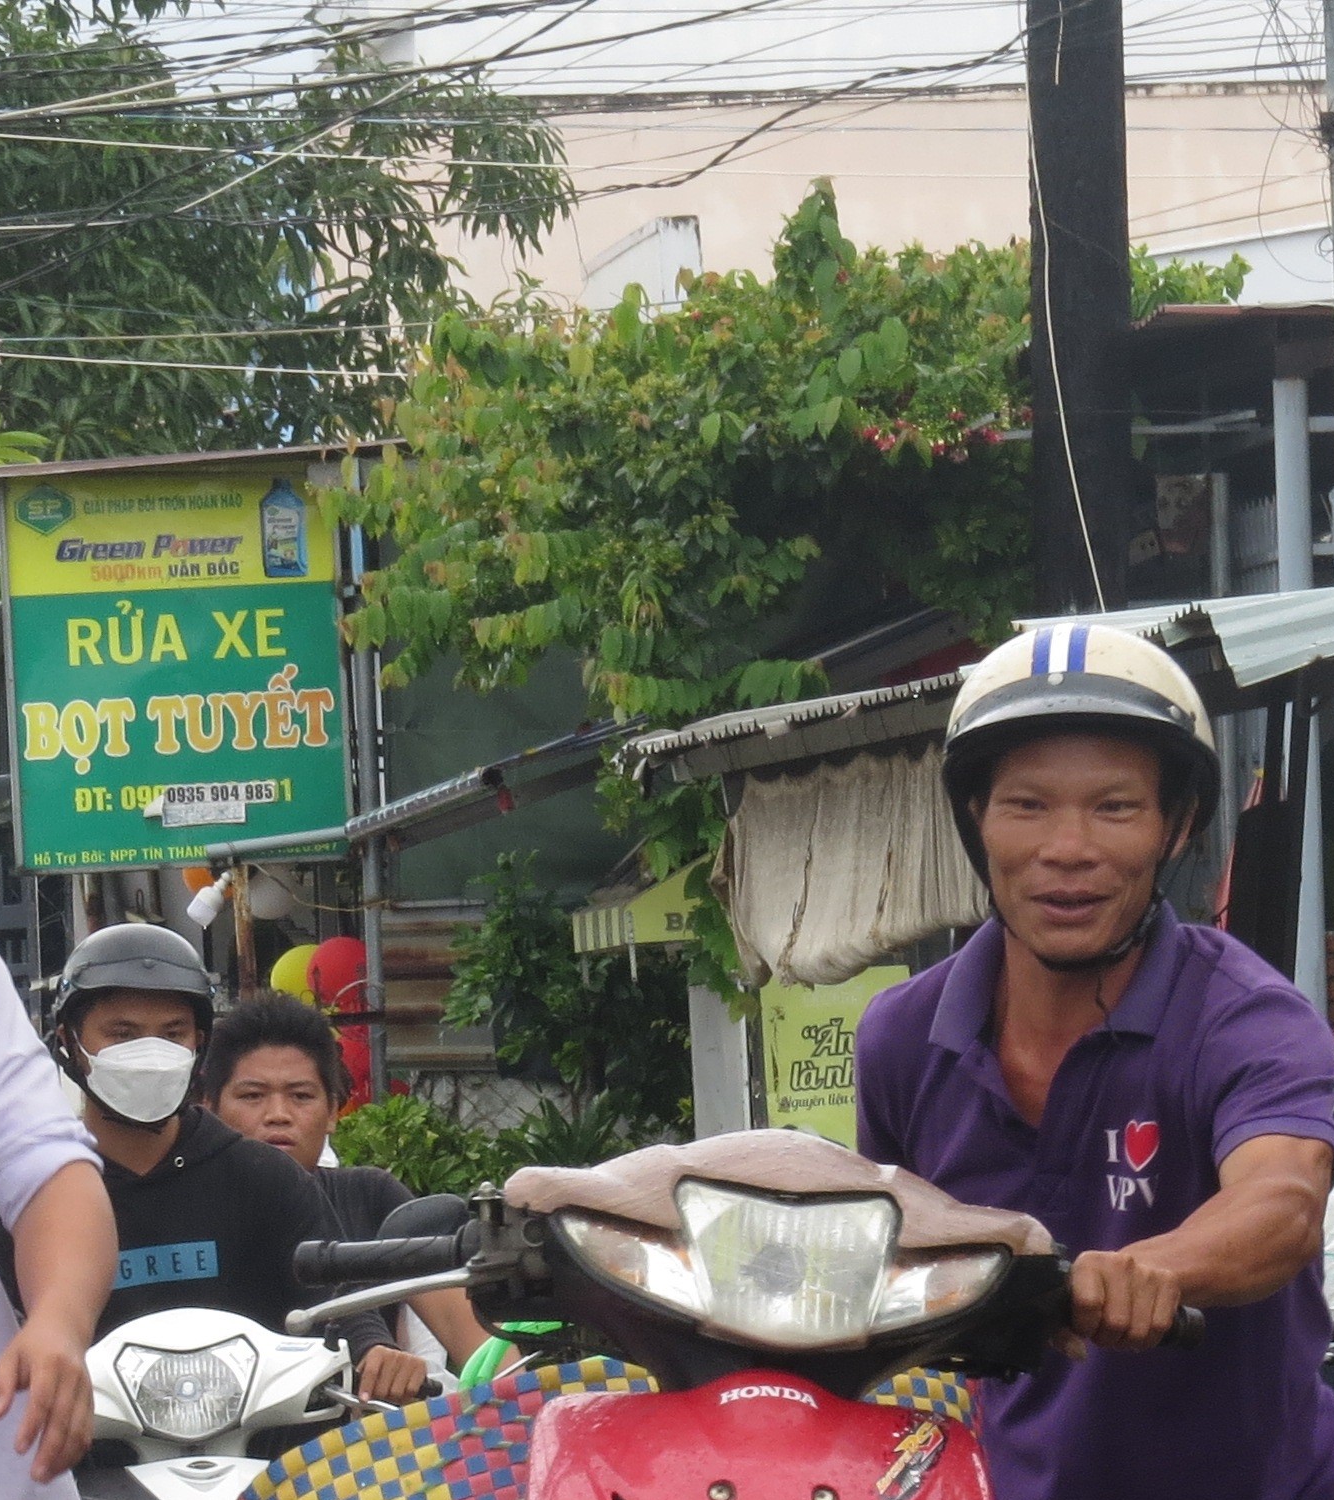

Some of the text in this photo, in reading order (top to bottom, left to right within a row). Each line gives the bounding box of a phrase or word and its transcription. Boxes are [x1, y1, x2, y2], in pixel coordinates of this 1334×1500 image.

[55, 533, 244, 562] Green Power
[68, 600, 288, 667] RỬA XE
[22, 663, 335, 776] BỌT TUYẾT
[75, 784, 113, 812] ĐT:
[168, 783, 273, 803] 0935 904 985
[110, 847, 137, 863] NPP
[789, 1057, 857, 1092] là nh
[1104, 1128, 1120, 1163] I
[720, 1385, 818, 1409] HONDA
